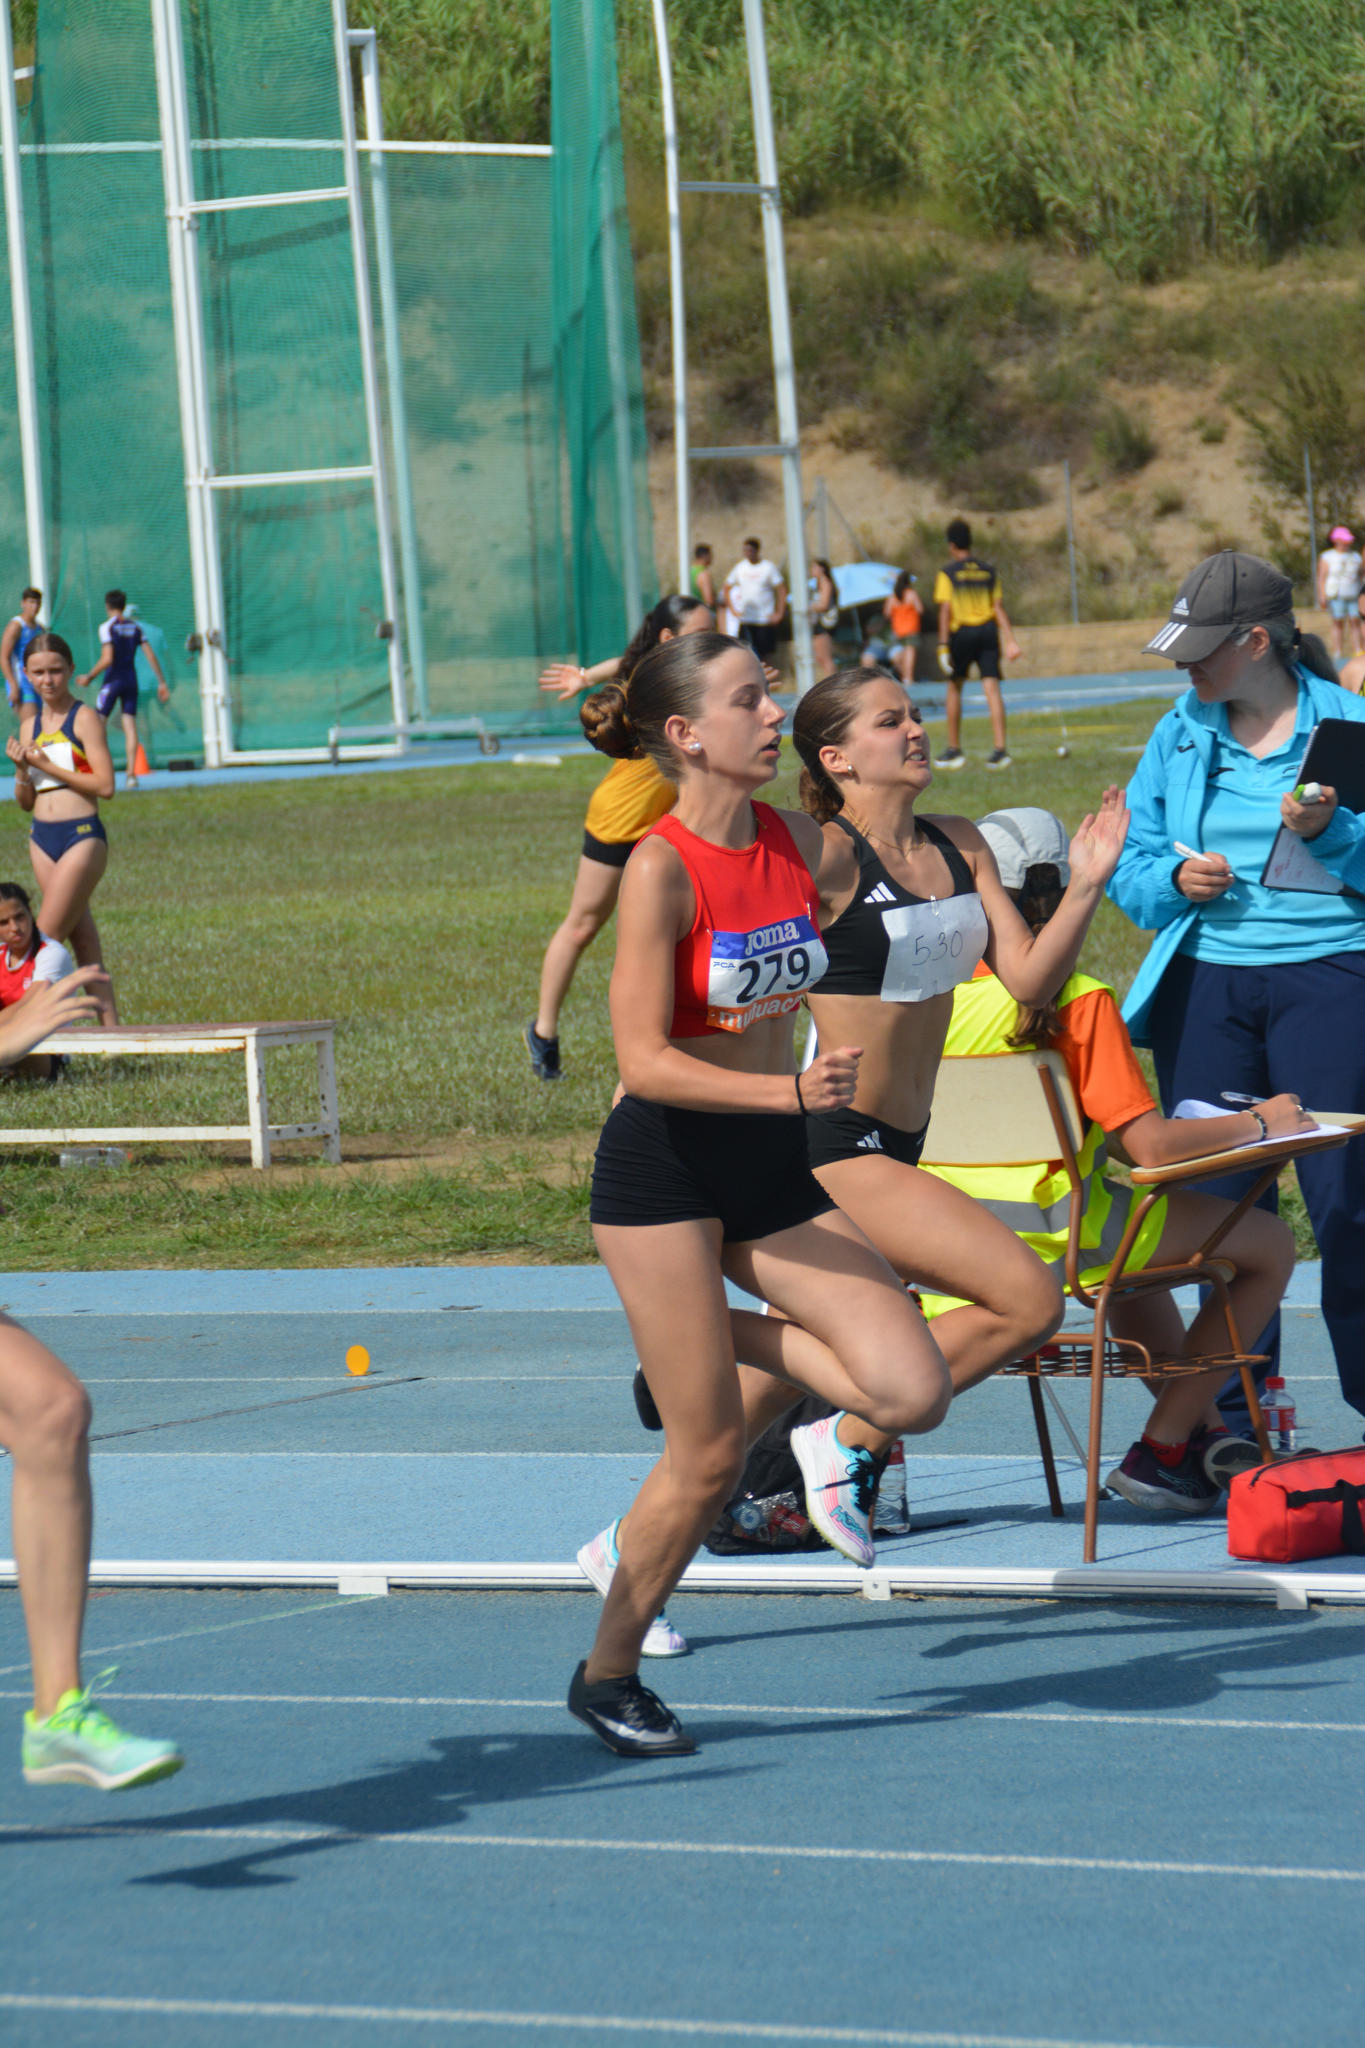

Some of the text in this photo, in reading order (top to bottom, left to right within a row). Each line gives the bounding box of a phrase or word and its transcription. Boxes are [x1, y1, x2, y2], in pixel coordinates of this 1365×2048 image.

[712, 961, 736, 969] FCA
[911, 930, 963, 966] 530
[736, 947, 810, 1004] 279
